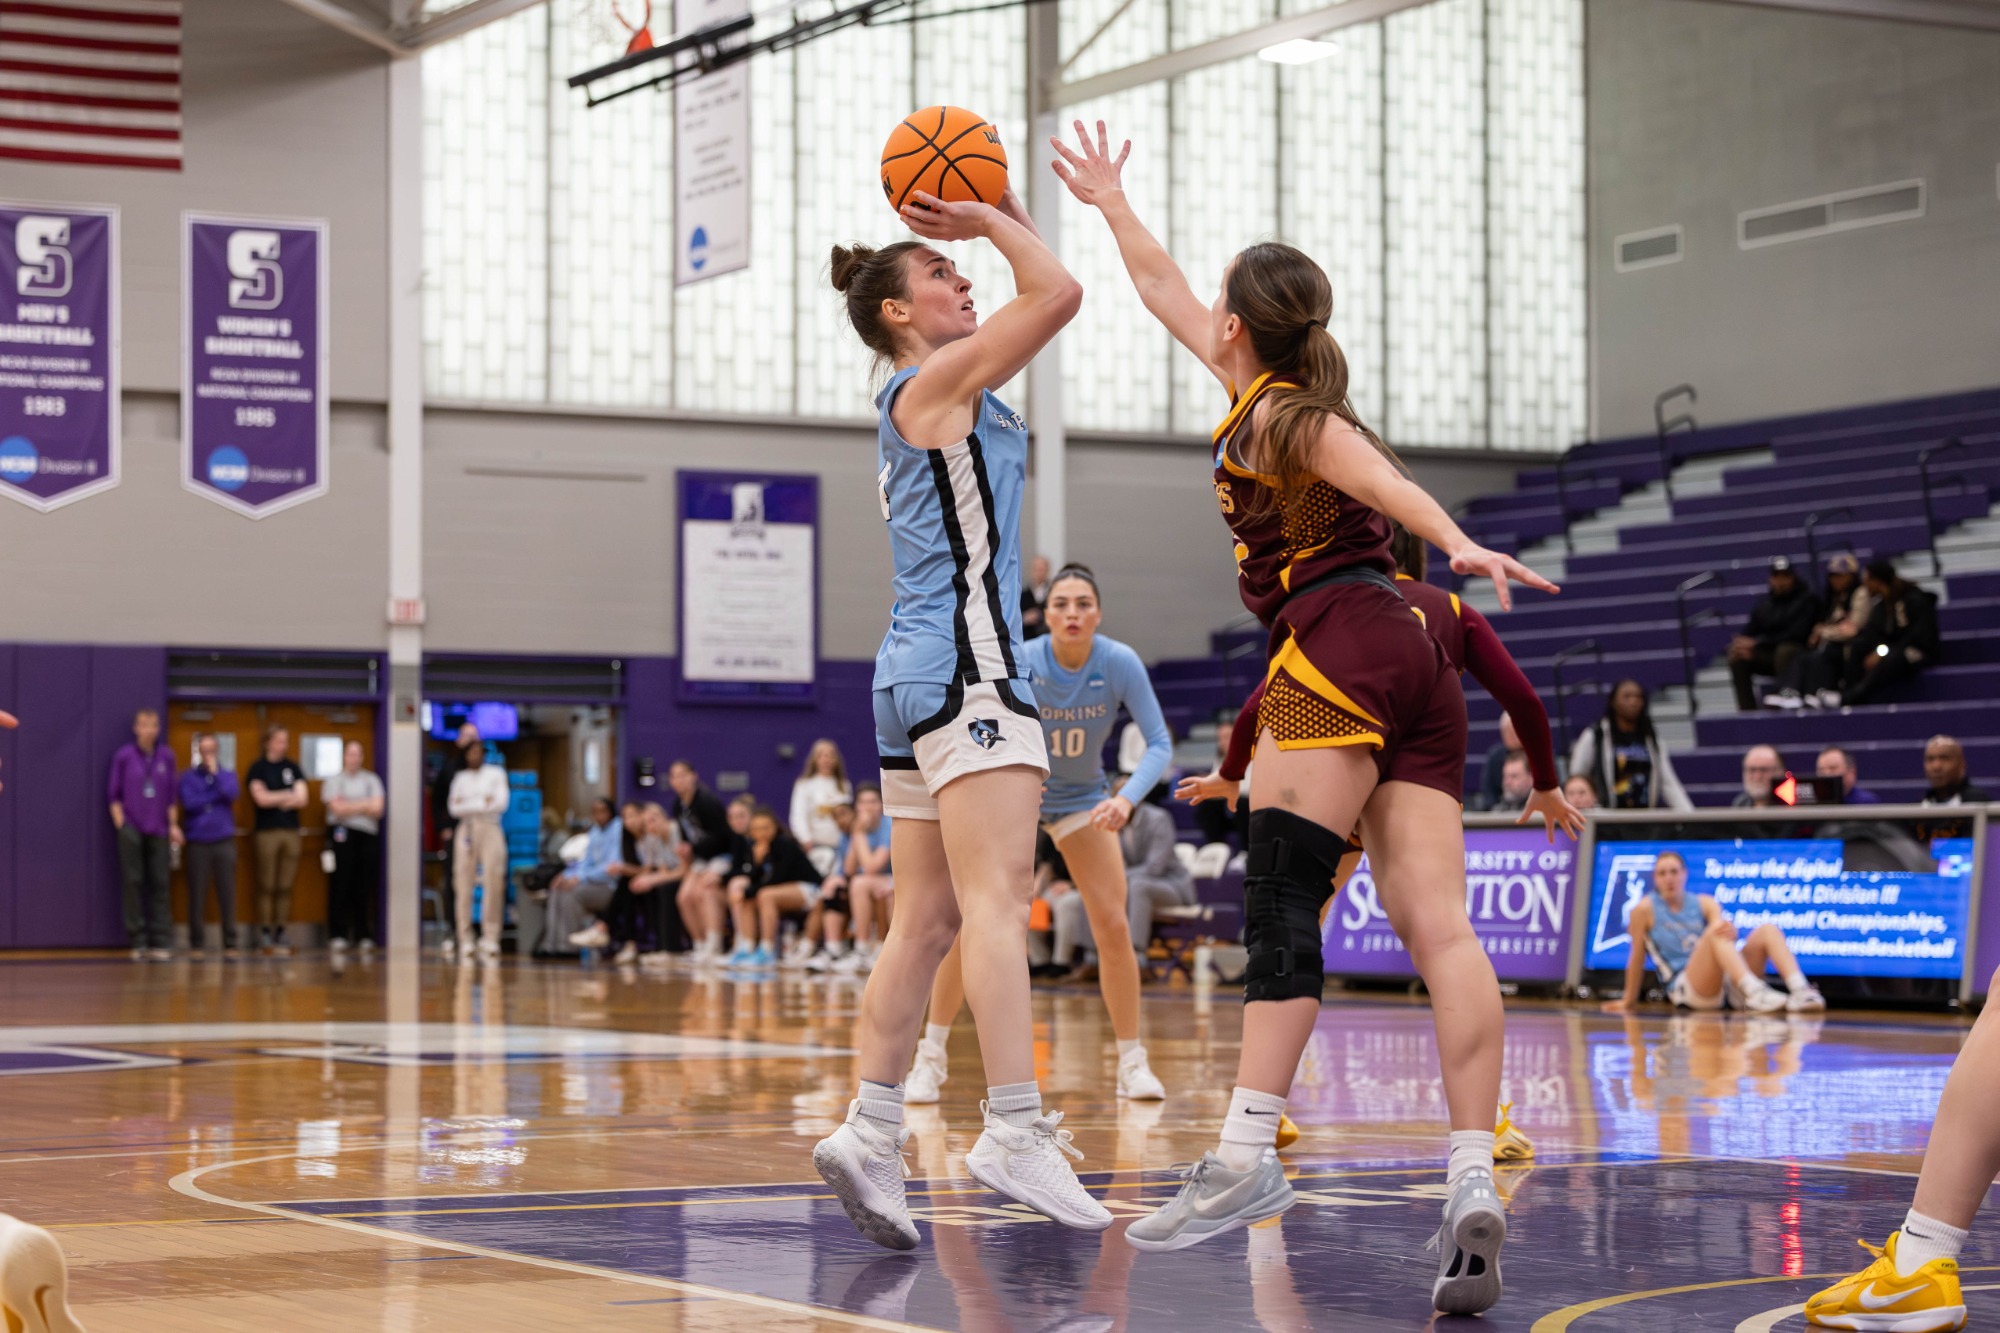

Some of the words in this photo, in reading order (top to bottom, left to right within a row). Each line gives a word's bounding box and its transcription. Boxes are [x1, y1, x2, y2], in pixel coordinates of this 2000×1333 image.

[204, 335, 305, 360] BASKETBALL
[1041, 703, 1107, 721] OPKINS
[1050, 727, 1086, 758] 10
[1538, 850, 1572, 871] OF
[1704, 858, 1723, 879] To
[1724, 858, 1760, 879] view
[1760, 857, 1788, 879] the
[1788, 857, 1843, 882] digital
[1714, 882, 1738, 904] for
[1738, 882, 1766, 904] the
[1766, 883, 1812, 904] NCAA
[1812, 883, 1879, 905] Division
[1880, 884, 1901, 905] III
[1733, 909, 1818, 930] Basketball
